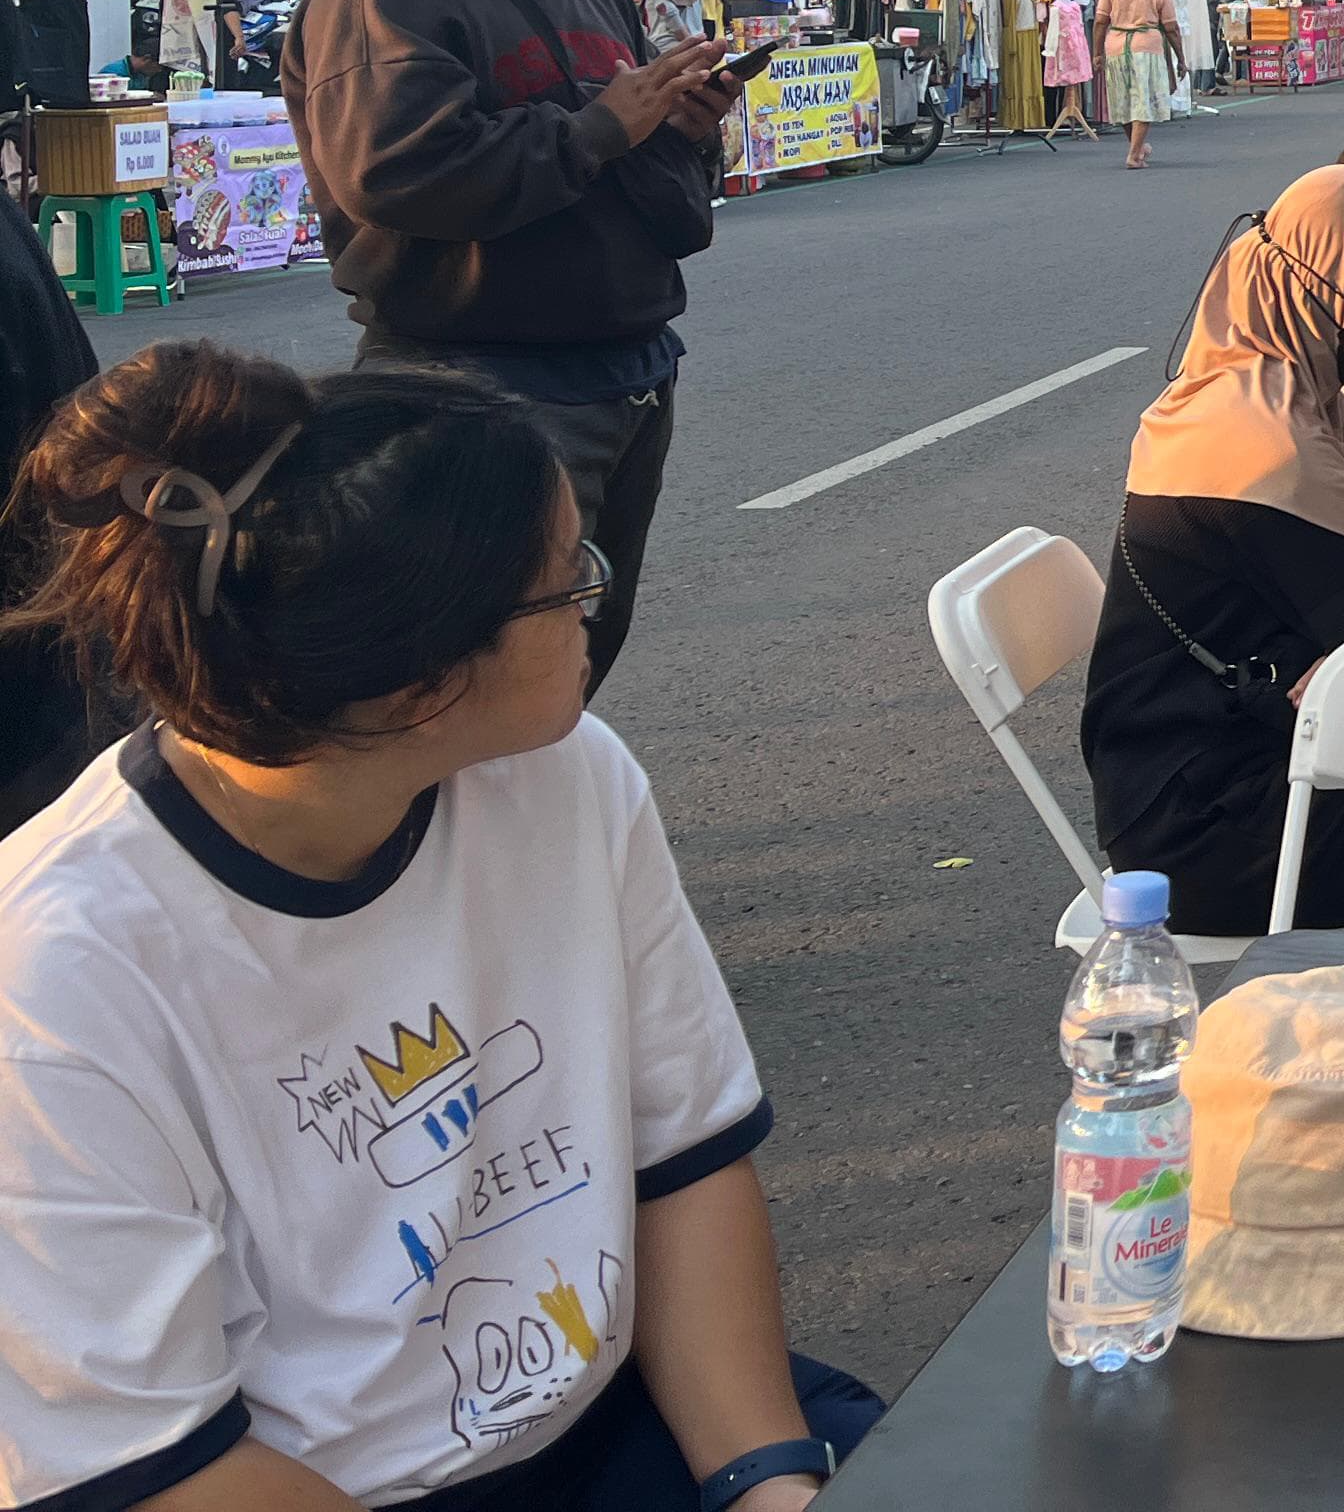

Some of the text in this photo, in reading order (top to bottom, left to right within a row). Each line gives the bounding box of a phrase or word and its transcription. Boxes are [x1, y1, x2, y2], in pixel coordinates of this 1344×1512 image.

[769, 54, 859, 80] ANEKA MINUMAN
[781, 80, 852, 111] MBAK HAN
[120, 129, 161, 146] SALAD BUAH
[783, 129, 824, 144] TEH HANGAT
[126, 157, 135, 173] Rp
[307, 1067, 362, 1113] NEW
[1150, 1215, 1172, 1239] Le
